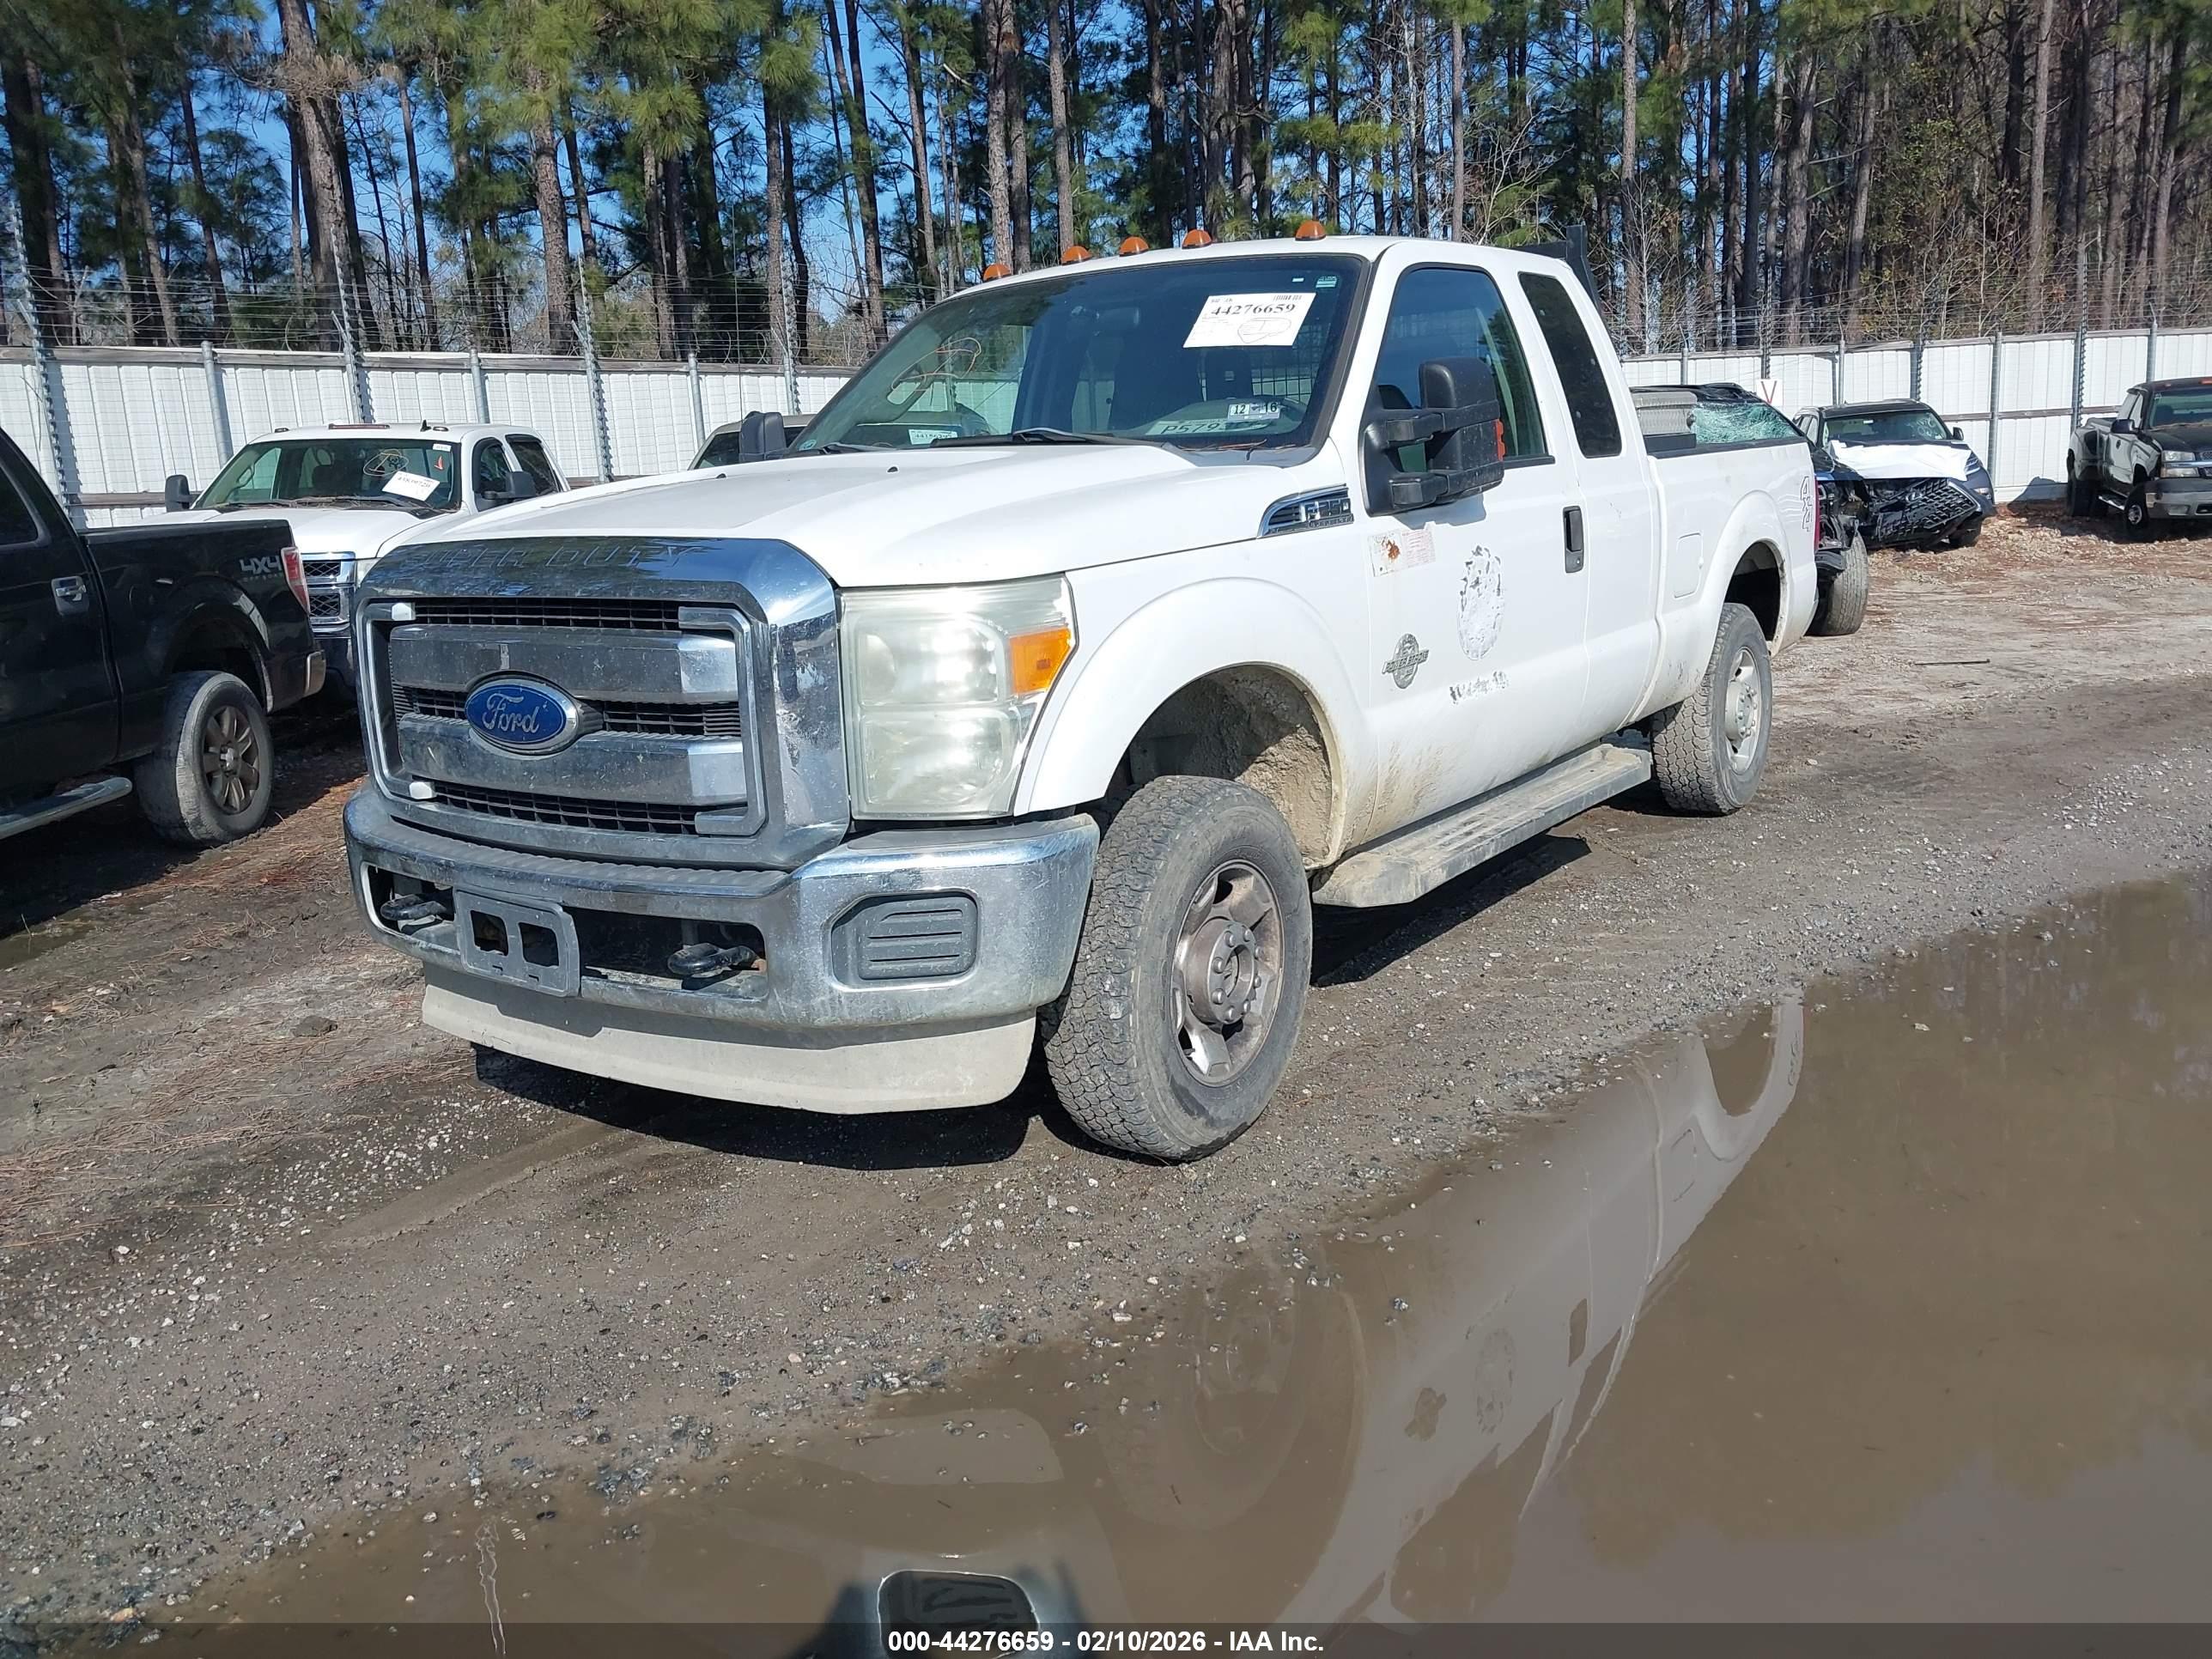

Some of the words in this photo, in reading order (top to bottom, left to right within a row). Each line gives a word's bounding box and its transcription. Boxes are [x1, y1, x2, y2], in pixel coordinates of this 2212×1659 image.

[1211, 303, 1296, 316] 44276659
[1760, 380, 1778, 404] V
[1233, 404, 1246, 415] 12
[1264, 402, 1278, 413] 16
[482, 692, 541, 733] Ford
